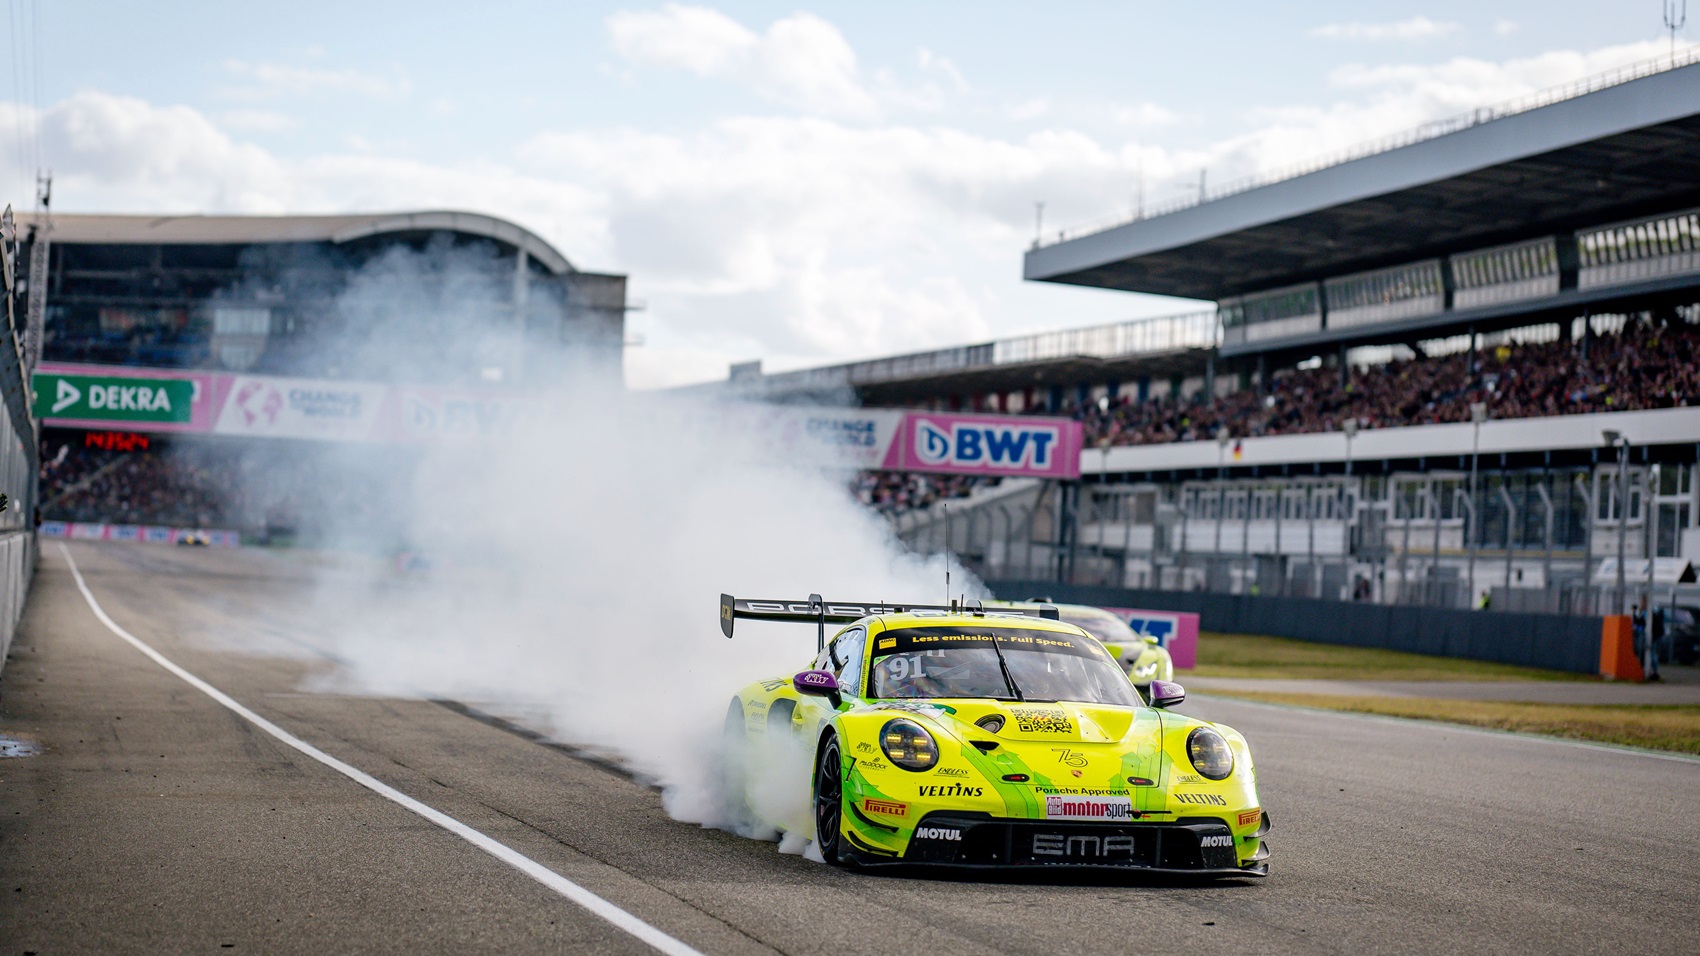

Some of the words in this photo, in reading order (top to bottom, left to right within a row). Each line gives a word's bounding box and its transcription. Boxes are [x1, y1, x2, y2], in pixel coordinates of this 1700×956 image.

[88, 384, 171, 412] DEKRA
[955, 427, 1054, 465] BWT
[1011, 636, 1033, 644] Full
[1036, 638, 1075, 648] Speed.
[890, 656, 926, 680] 91
[1051, 748, 1088, 768] 75
[919, 784, 983, 797] VELTINS
[1081, 788, 1130, 796] Approved
[1174, 794, 1227, 806] VELTINS
[865, 800, 906, 815] PIRELLI
[916, 827, 962, 841] MOTUL
[1033, 834, 1135, 857] EMA
[1201, 836, 1233, 848] MOTUL
